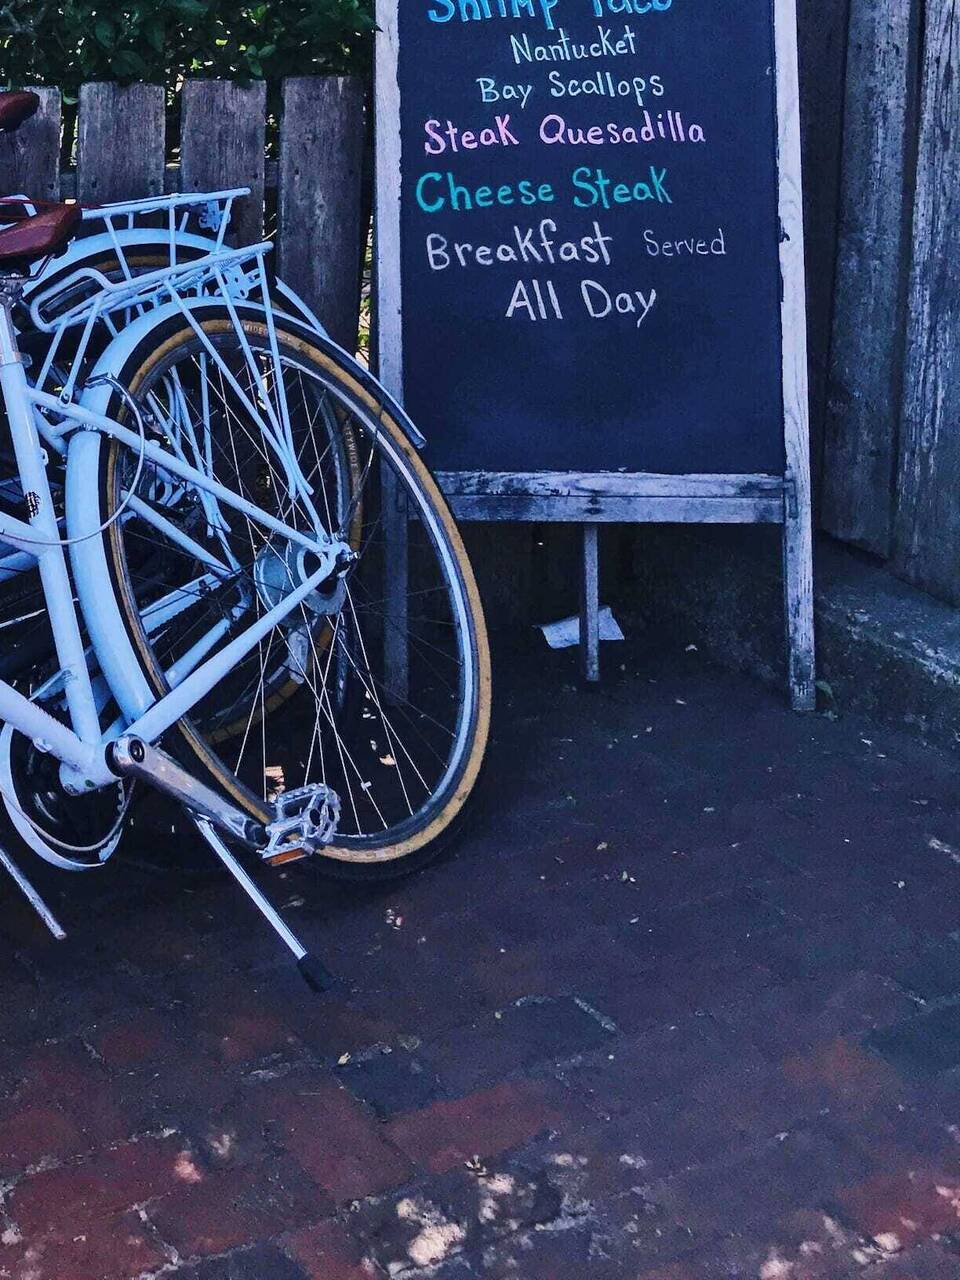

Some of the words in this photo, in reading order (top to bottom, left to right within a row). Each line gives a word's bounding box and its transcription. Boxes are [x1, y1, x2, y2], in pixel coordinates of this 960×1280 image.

[510, 25, 637, 65] Nantucket
[475, 77, 533, 109] Bay
[548, 71, 665, 106] Scallops
[424, 113, 520, 156] Steak
[539, 111, 706, 146] Quesadilla
[415, 171, 554, 213] Cheese
[571, 166, 673, 209] Steak
[425, 218, 614, 270] Breakfast
[643, 227, 726, 257] Served
[504, 279, 563, 321] All
[580, 280, 657, 328] Day
